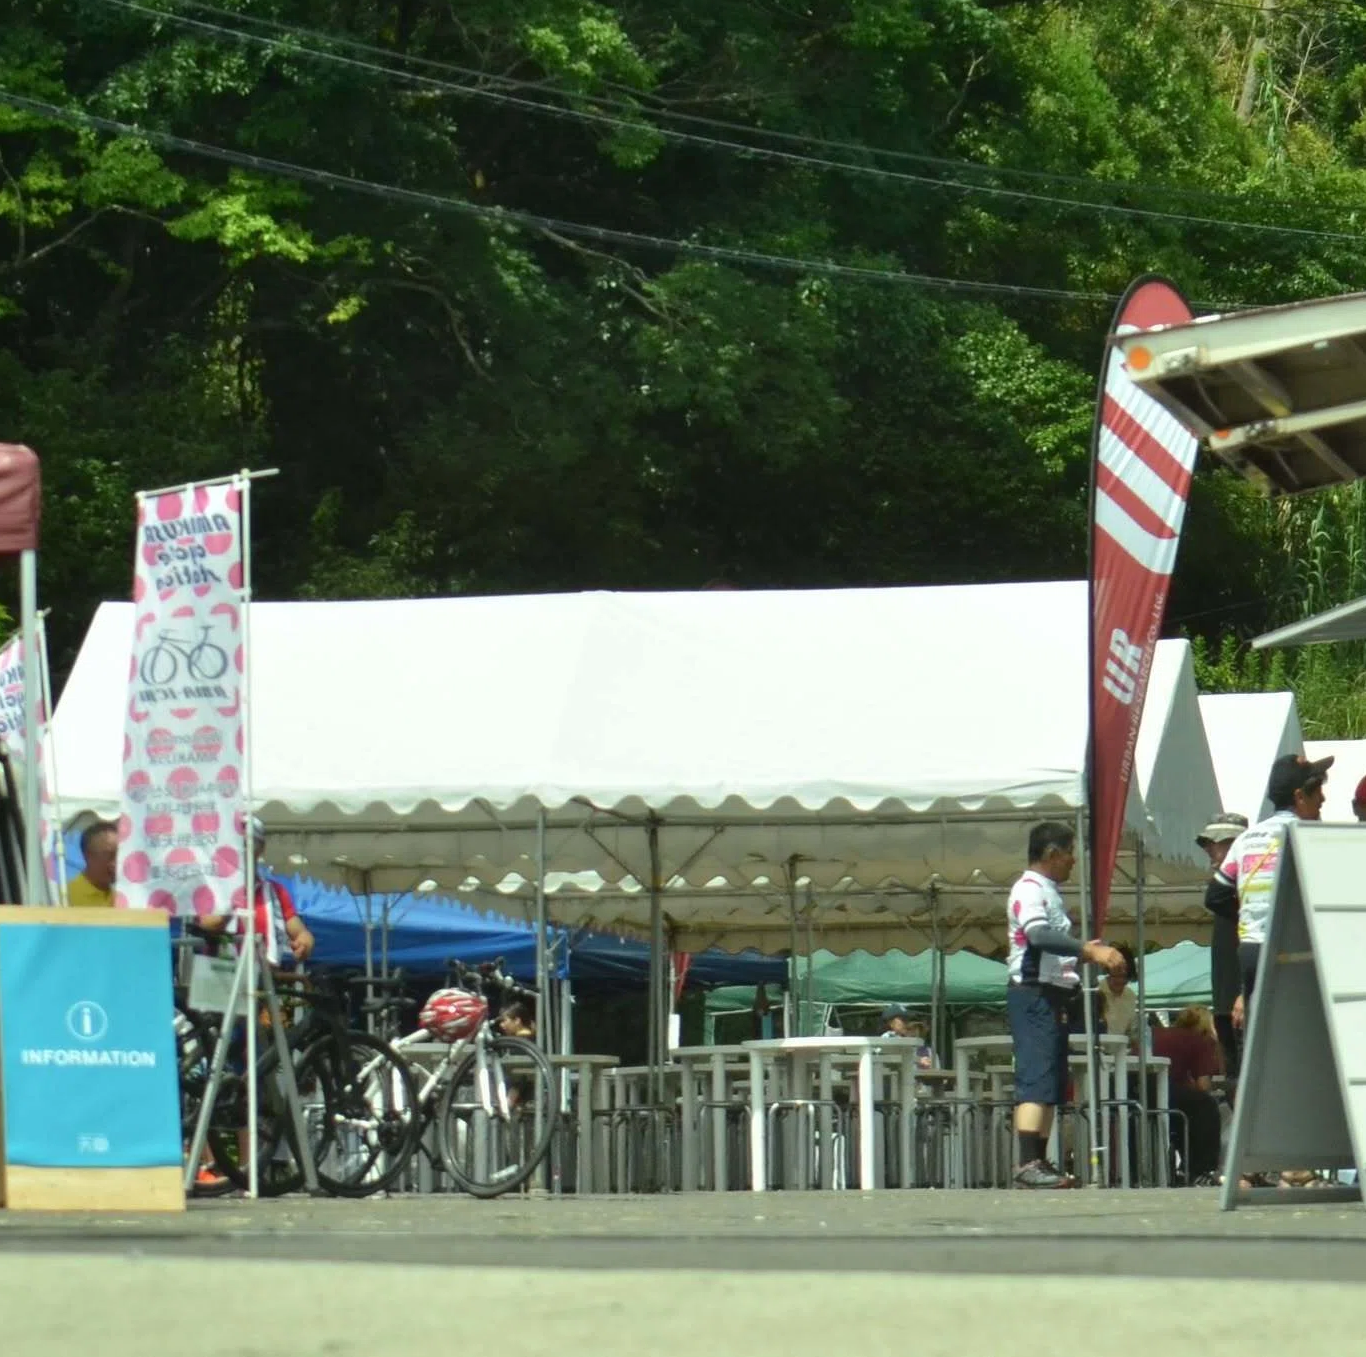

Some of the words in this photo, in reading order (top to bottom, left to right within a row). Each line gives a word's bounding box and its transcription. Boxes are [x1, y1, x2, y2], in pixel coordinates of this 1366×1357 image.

[1102, 627, 1143, 705] UR
[1120, 727, 1137, 783] URBAN
[21, 1049, 156, 1069] INFORMATION
